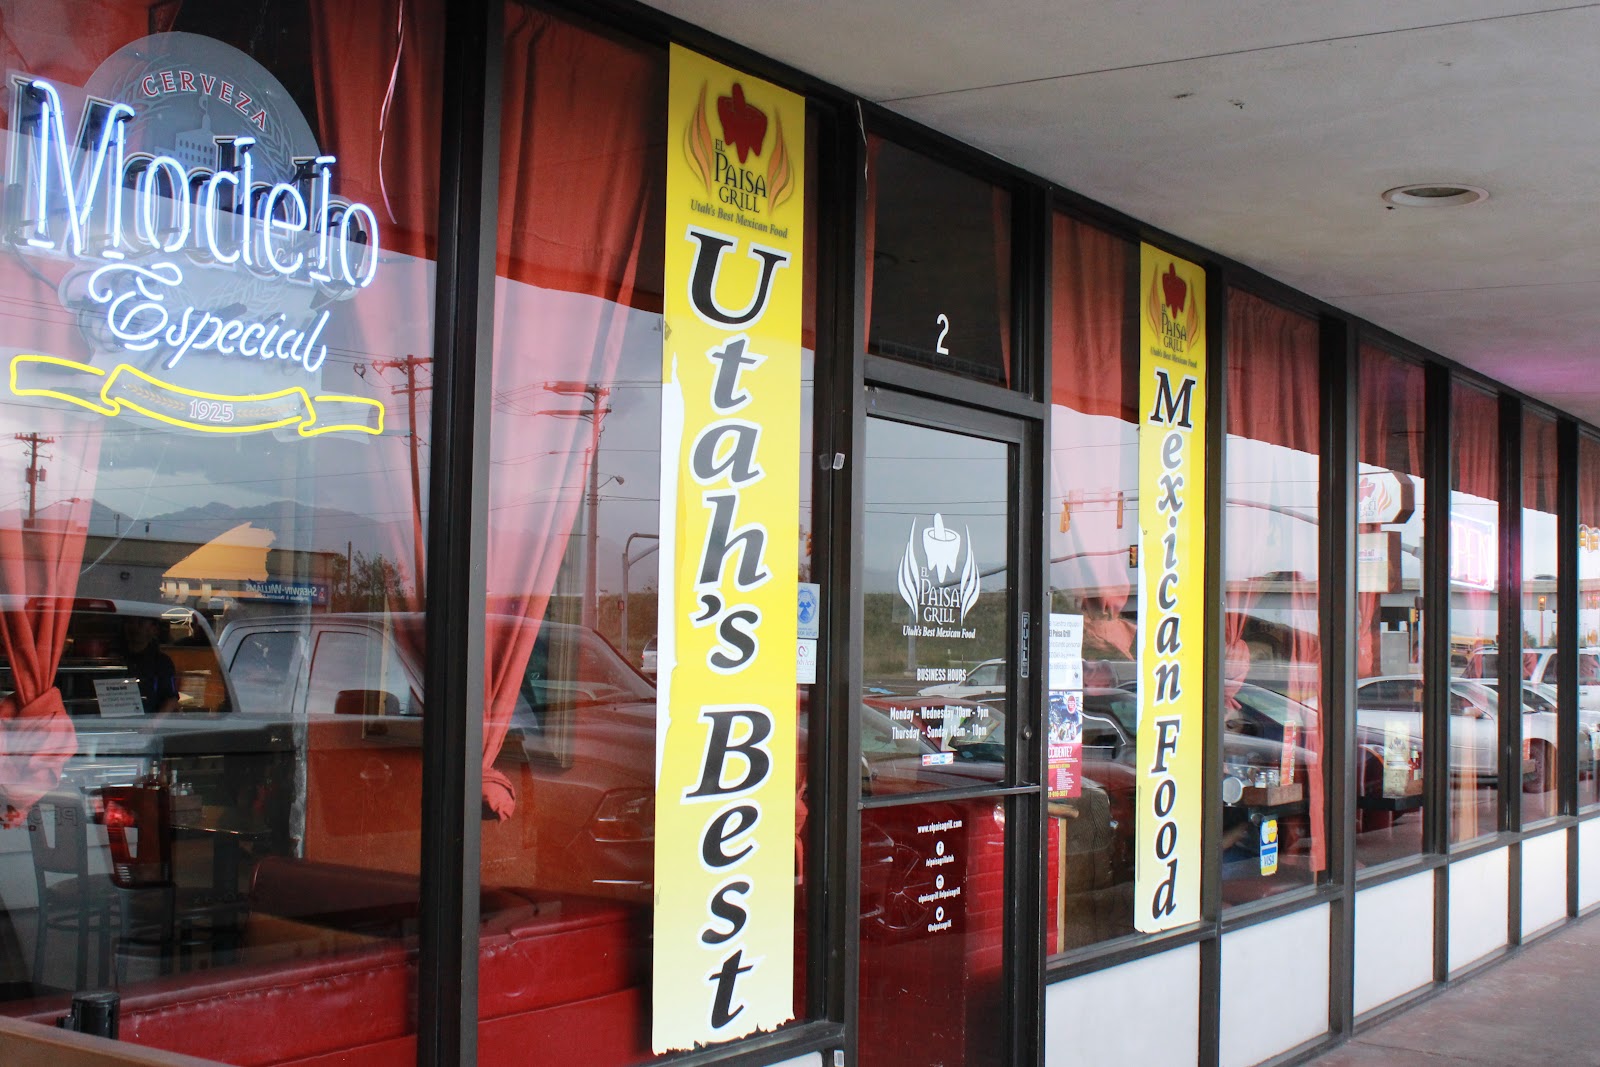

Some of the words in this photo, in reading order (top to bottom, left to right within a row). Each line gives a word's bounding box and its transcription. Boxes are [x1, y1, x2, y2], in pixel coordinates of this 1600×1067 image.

[142, 71, 267, 132] CERVEZA
[714, 138, 726, 152] EL
[18, 78, 380, 289] Modelo
[714, 151, 768, 198] PAISA
[719, 186, 760, 214] GRILL
[690, 198, 716, 216] Utah's
[718, 208, 734, 222] Best
[736, 213, 768, 232] Mexican
[770, 224, 788, 238] Food
[88, 262, 330, 372] Especial
[1162, 312, 1187, 341] PAISA
[936, 313, 950, 356] 2
[1164, 336, 1184, 352] GRILL
[189, 400, 234, 423] 1925
[687, 227, 790, 672] Utah's
[1149, 369, 1197, 702] Mexican
[921, 567, 929, 578] EL
[920, 578, 960, 608] PAISA
[924, 607, 956, 625] GRILL
[902, 625, 922, 636] Utah's
[922, 626, 936, 637] Best
[936, 627, 960, 638] Mexican
[961, 628, 976, 638] Food
[916, 668, 946, 681] BUSINESS
[948, 668, 967, 681] HOURS
[890, 706, 914, 722] Monday
[921, 706, 954, 720] Wednesday
[956, 706, 971, 718] 10am
[977, 706, 989, 721] 9pm
[892, 727, 920, 741] Thursday
[927, 725, 948, 739] Sunday
[950, 725, 965, 737] 10am
[972, 724, 987, 738] 10pm
[1048, 746, 1072, 758] CCIDENTE?
[1150, 719, 1180, 920] Food
[684, 708, 772, 1031] Best
[1264, 854, 1275, 866] VISA
